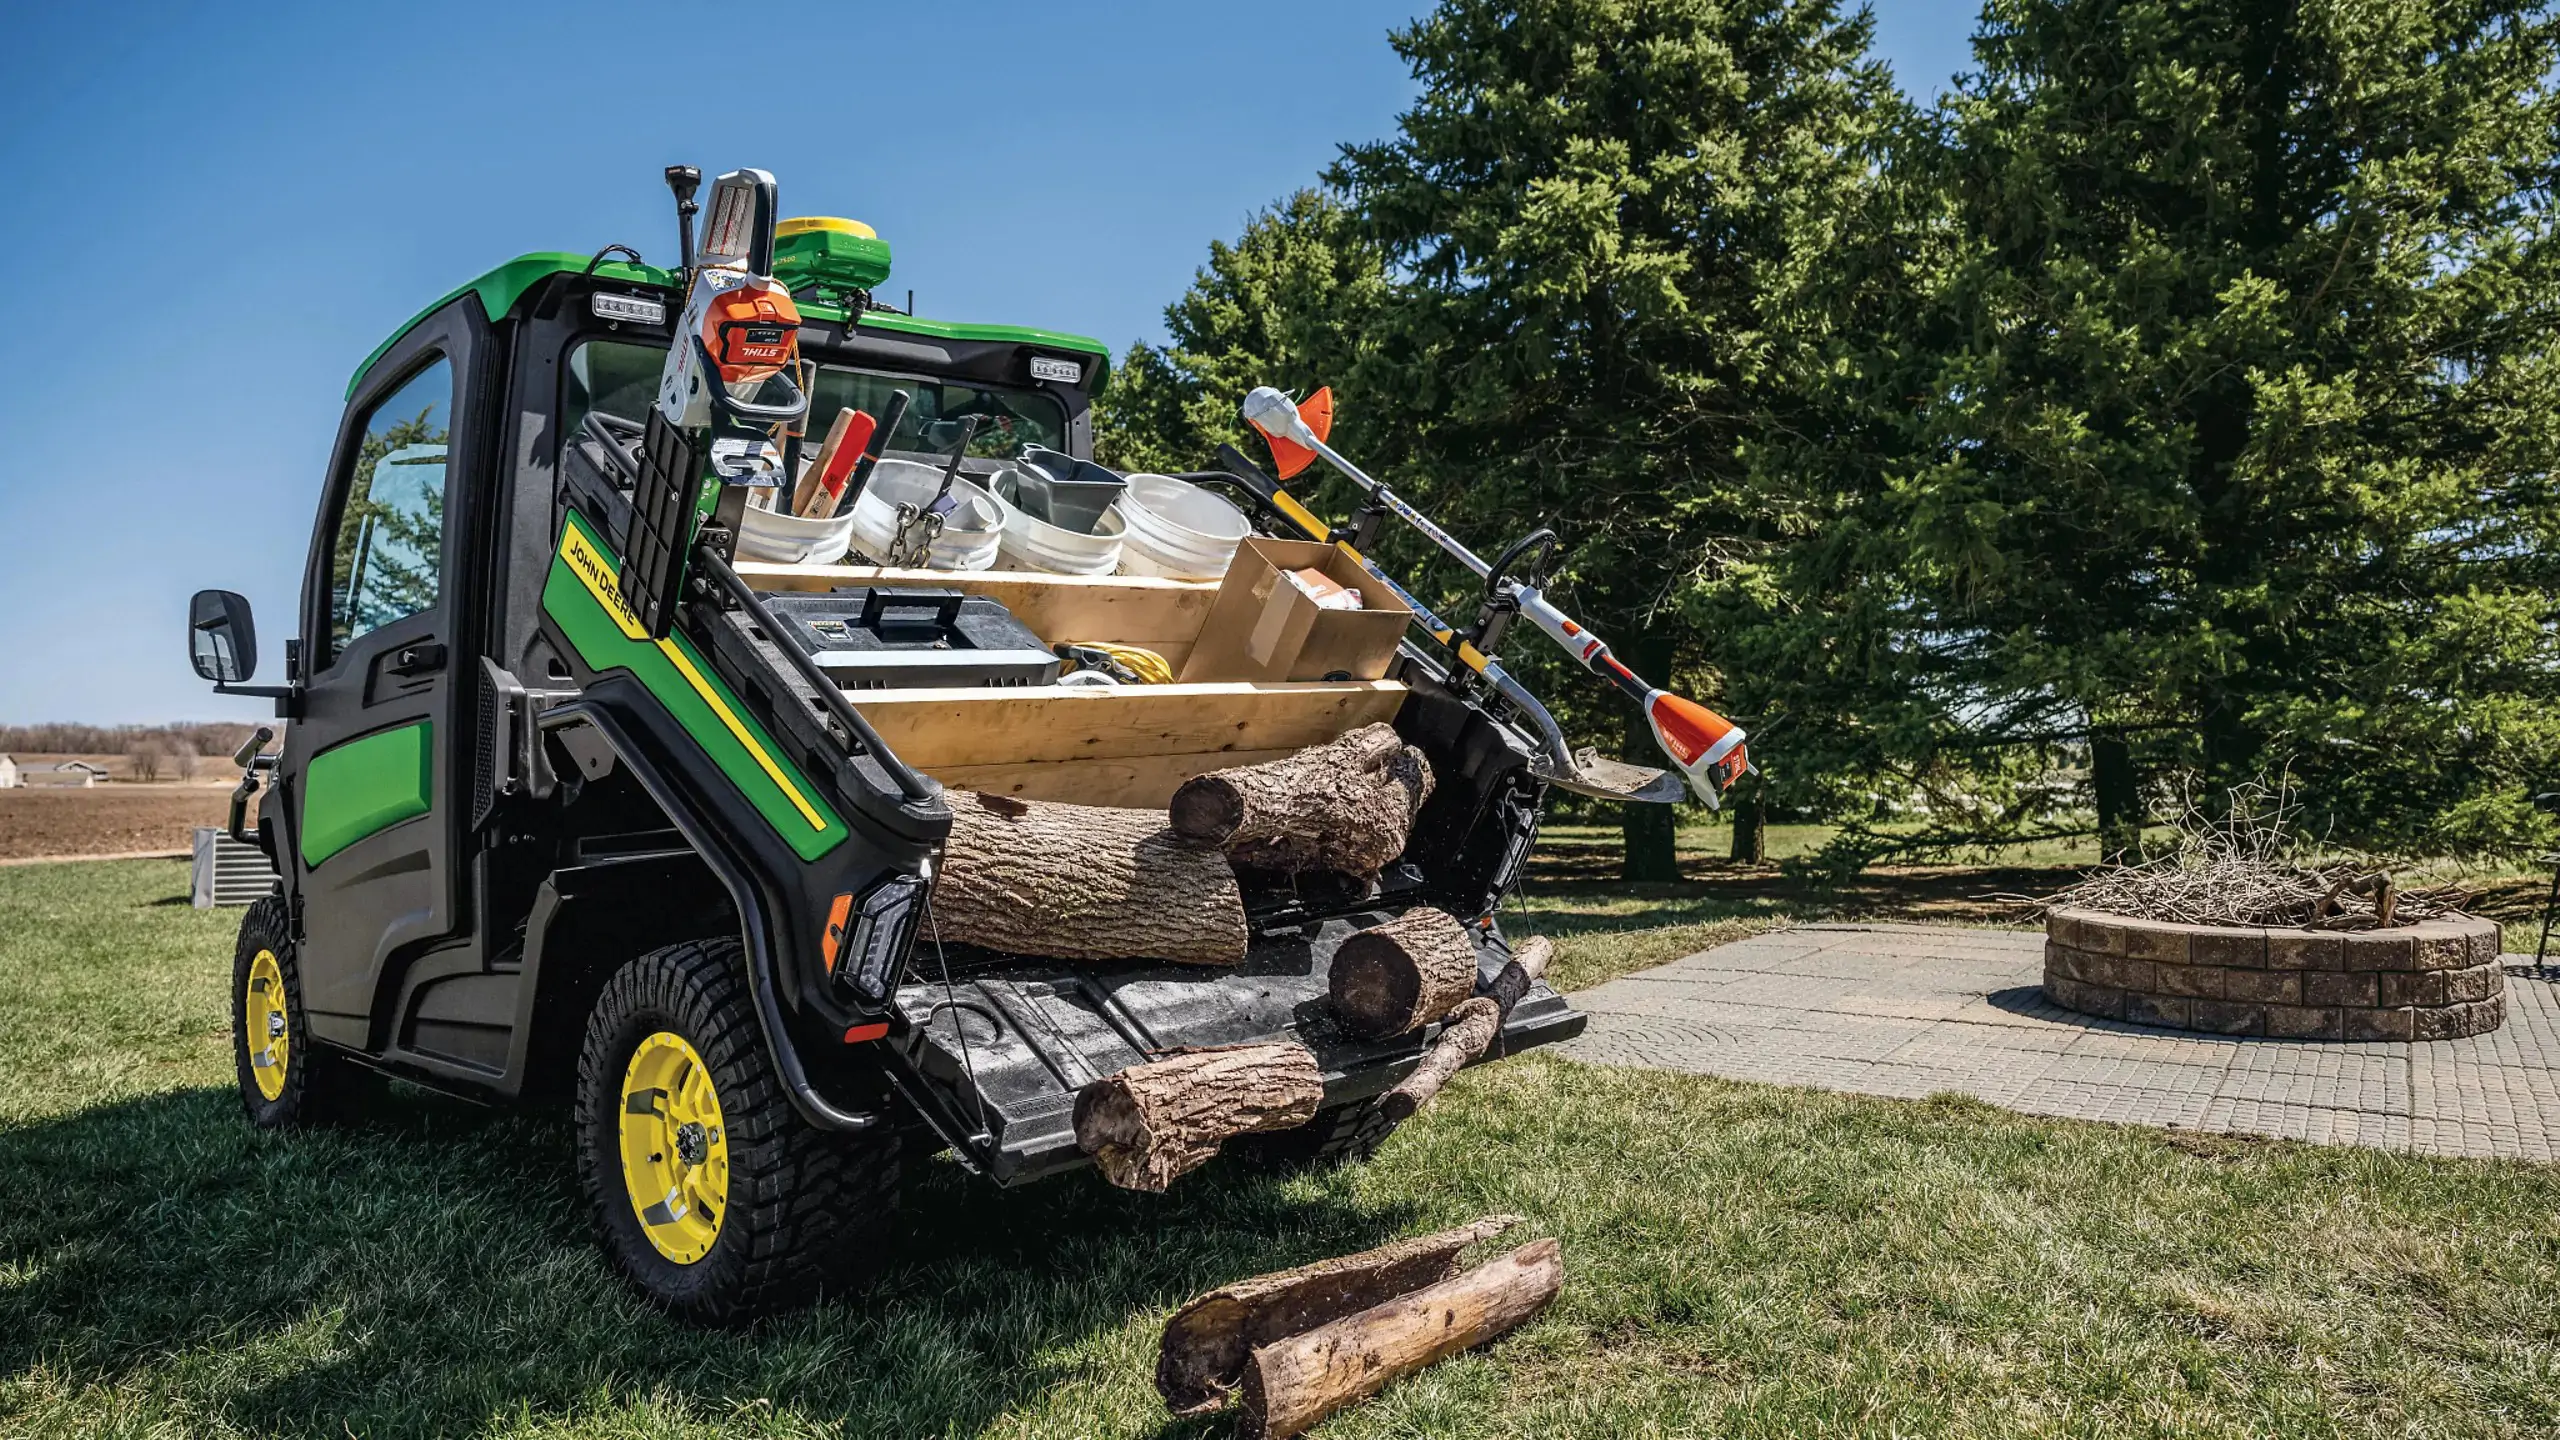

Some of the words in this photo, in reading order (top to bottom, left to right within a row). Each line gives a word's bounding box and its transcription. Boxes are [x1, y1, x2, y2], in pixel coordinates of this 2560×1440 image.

[742, 347, 779, 357] STIHL
[570, 541, 600, 581] JOHN
[599, 572, 635, 627] DEERE
